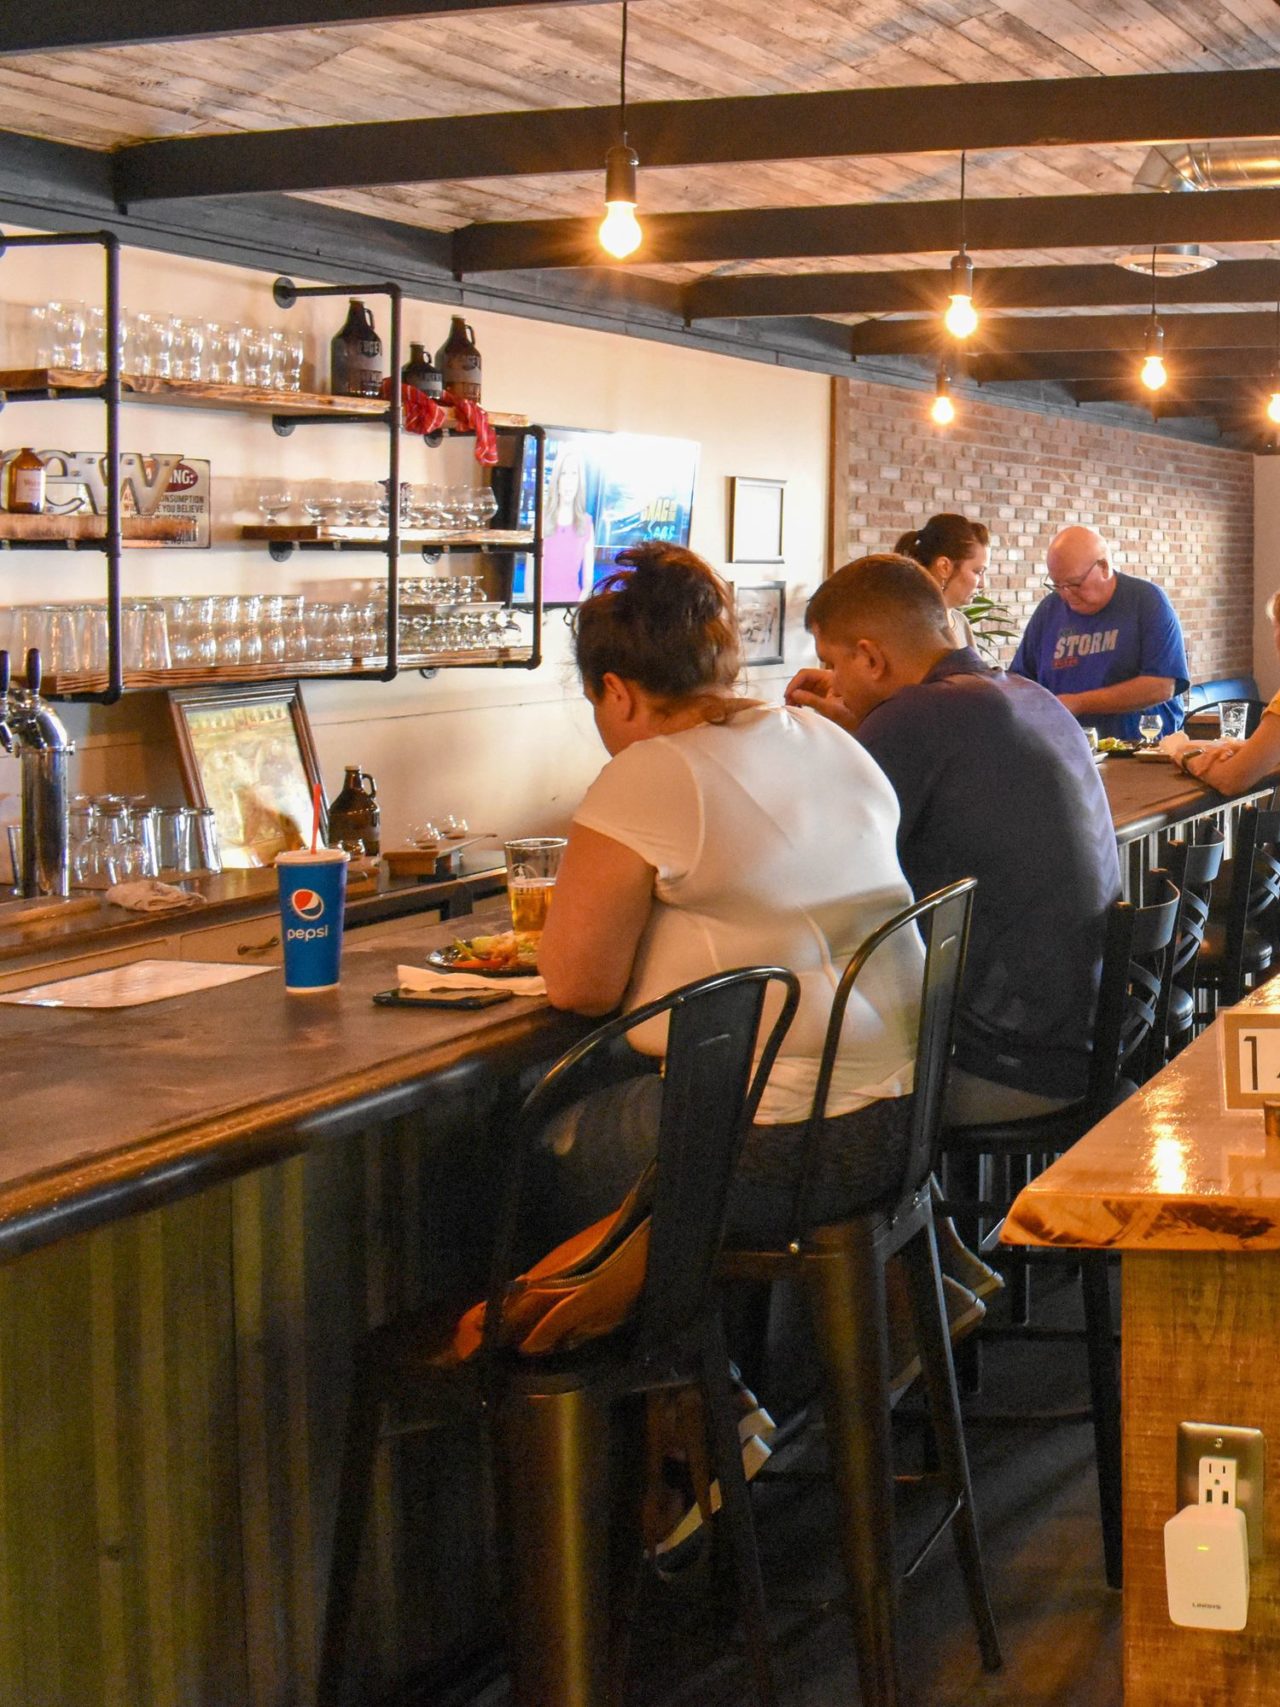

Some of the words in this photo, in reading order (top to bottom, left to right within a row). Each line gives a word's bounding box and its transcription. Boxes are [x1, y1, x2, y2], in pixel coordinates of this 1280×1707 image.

[177, 505, 204, 514] BELIEVE
[1053, 628, 1119, 660] STORM
[287, 924, 329, 942] pepsi
